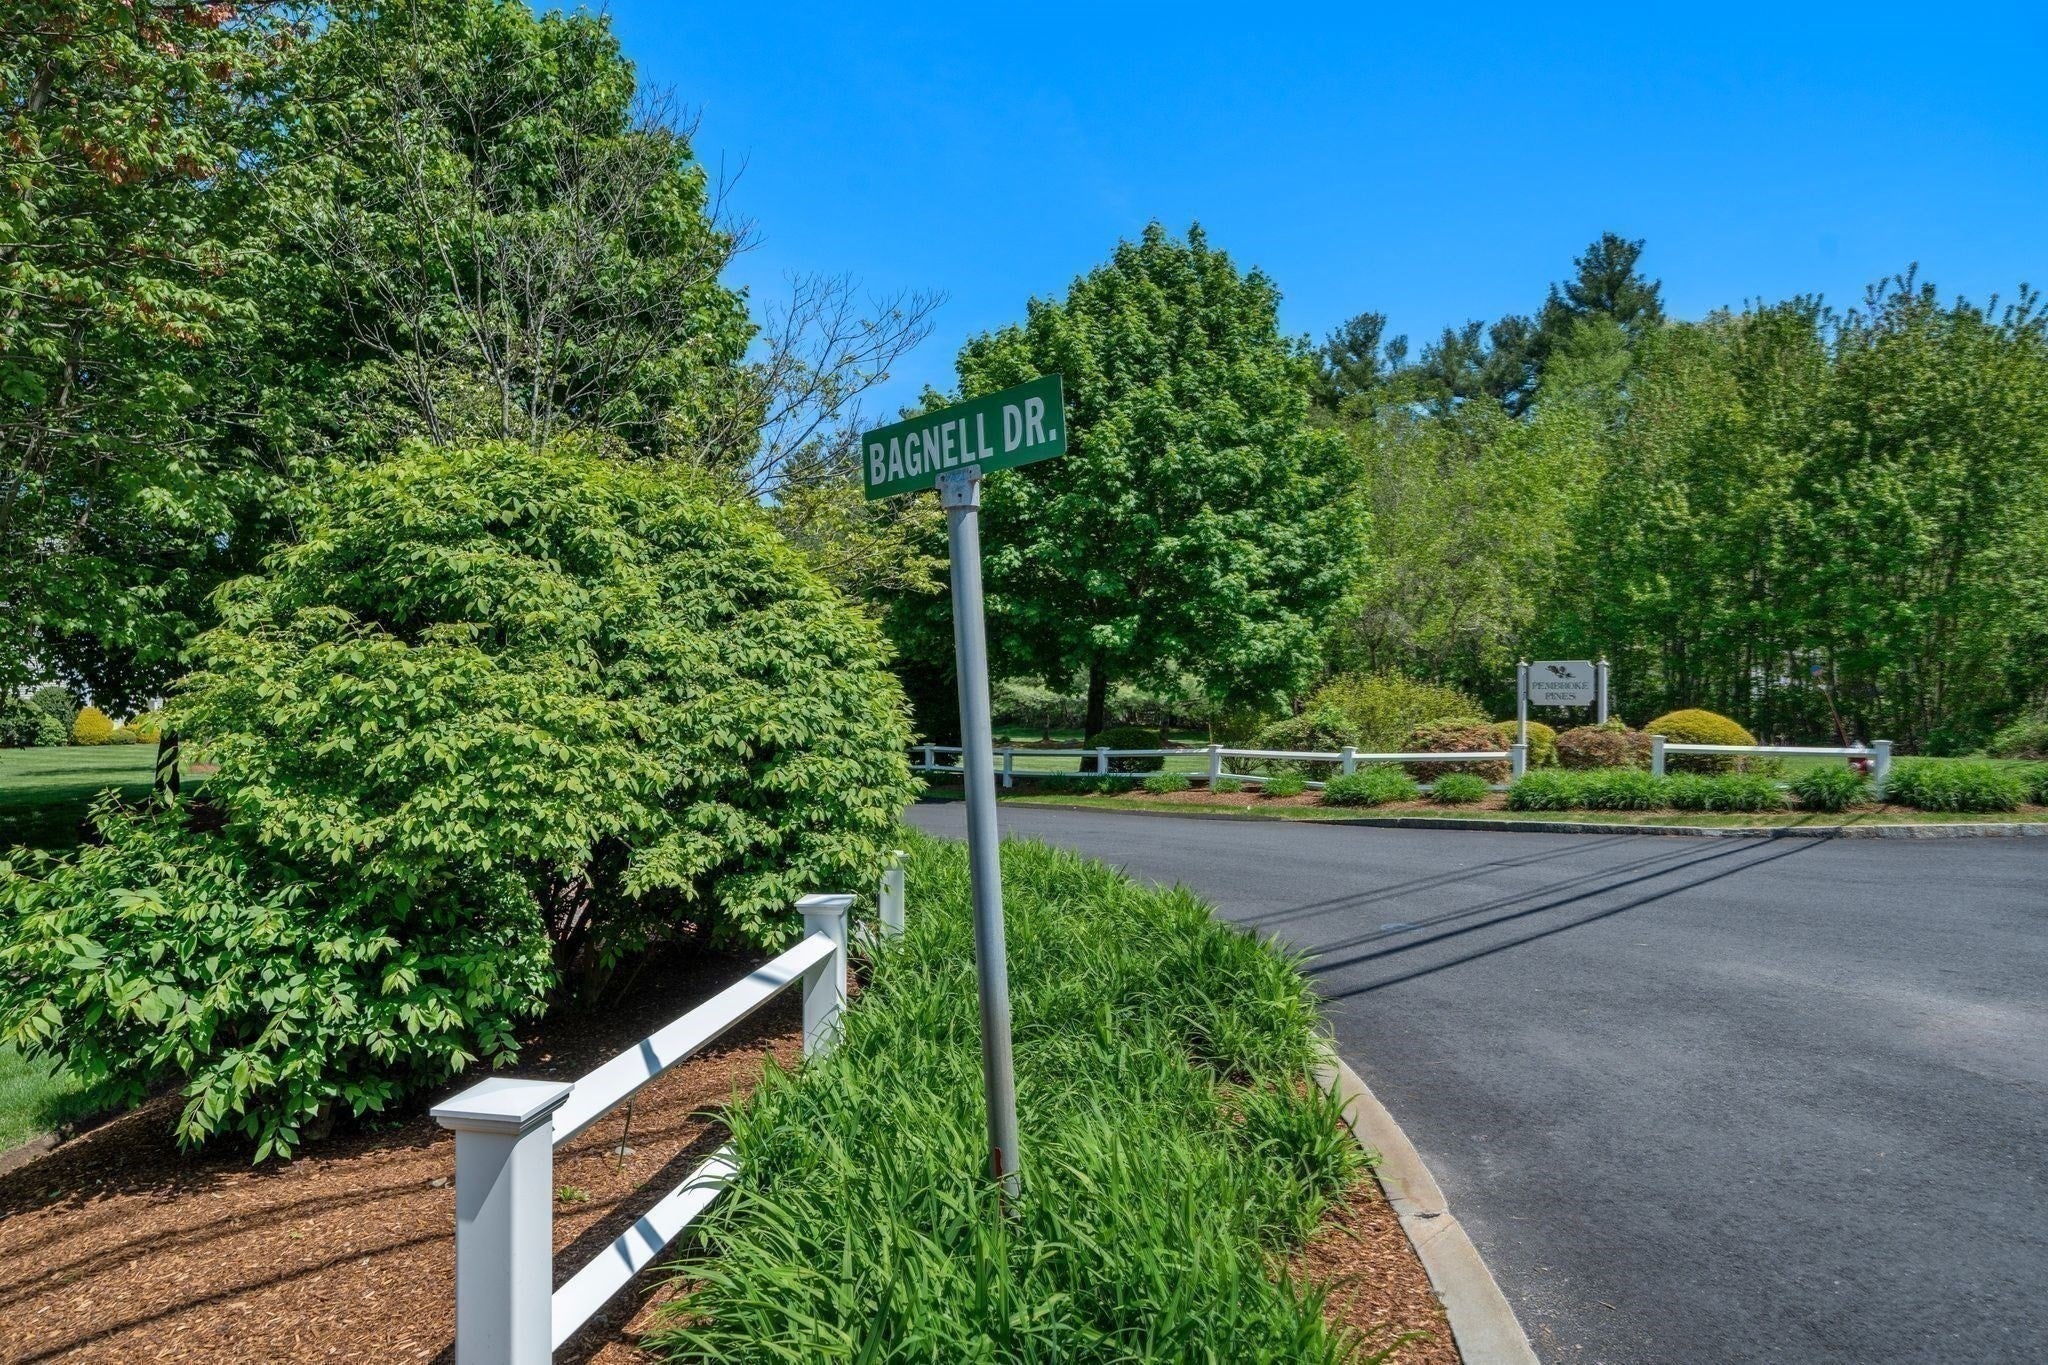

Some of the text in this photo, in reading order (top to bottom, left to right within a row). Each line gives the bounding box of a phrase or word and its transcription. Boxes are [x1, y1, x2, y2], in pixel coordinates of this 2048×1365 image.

[869, 397, 1056, 486] BAGNELL DR.
[1532, 681, 1589, 690] PEMBROKE
[1545, 692, 1576, 700] PINES
